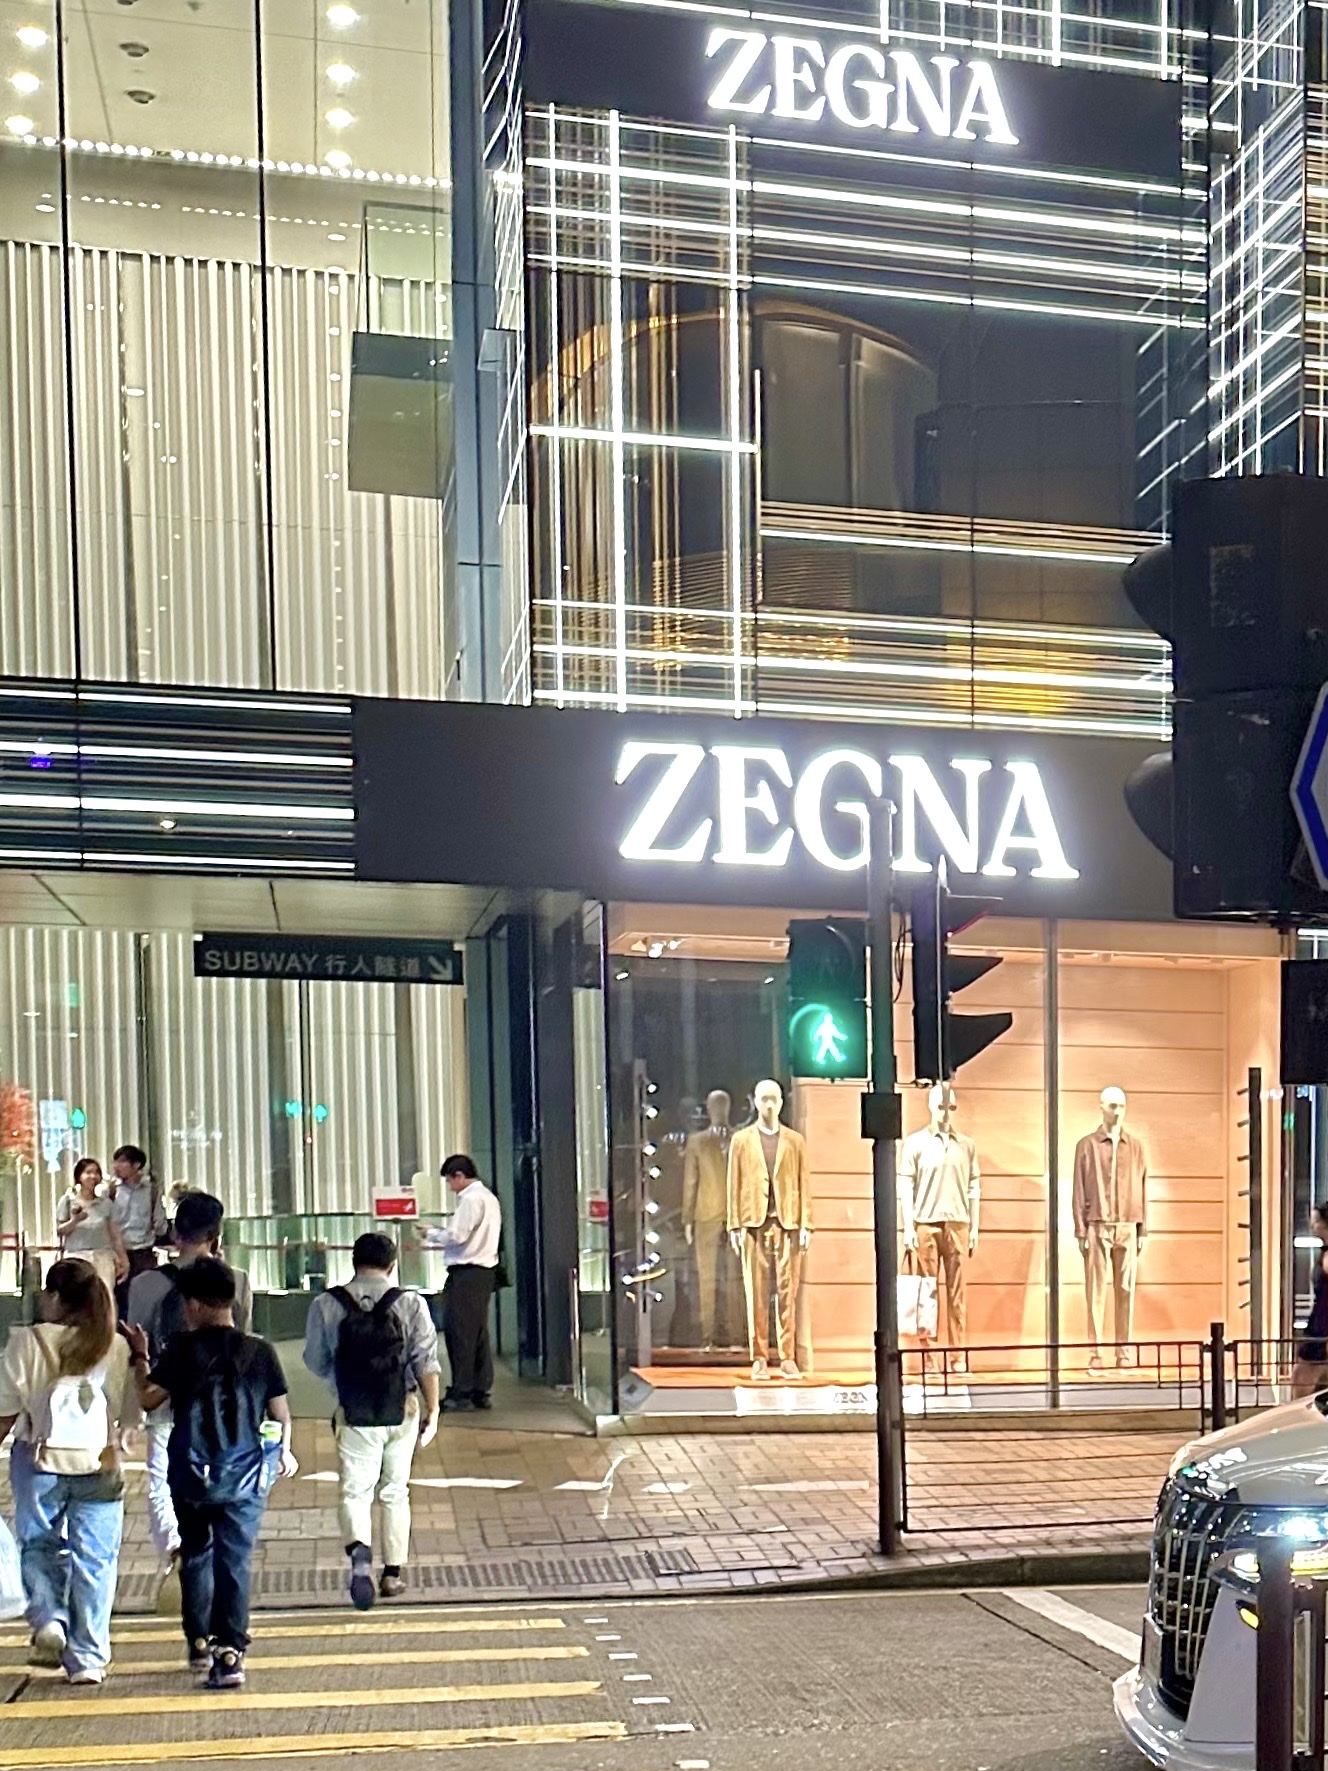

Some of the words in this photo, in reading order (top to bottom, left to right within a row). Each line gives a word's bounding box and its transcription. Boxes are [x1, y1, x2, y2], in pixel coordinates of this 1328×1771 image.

[704, 26, 1021, 146] ZEGNA
[613, 740, 1081, 880] ZEGNA
[204, 950, 319, 973] SUBWAY
[324, 953, 421, 978] 行人隧道
